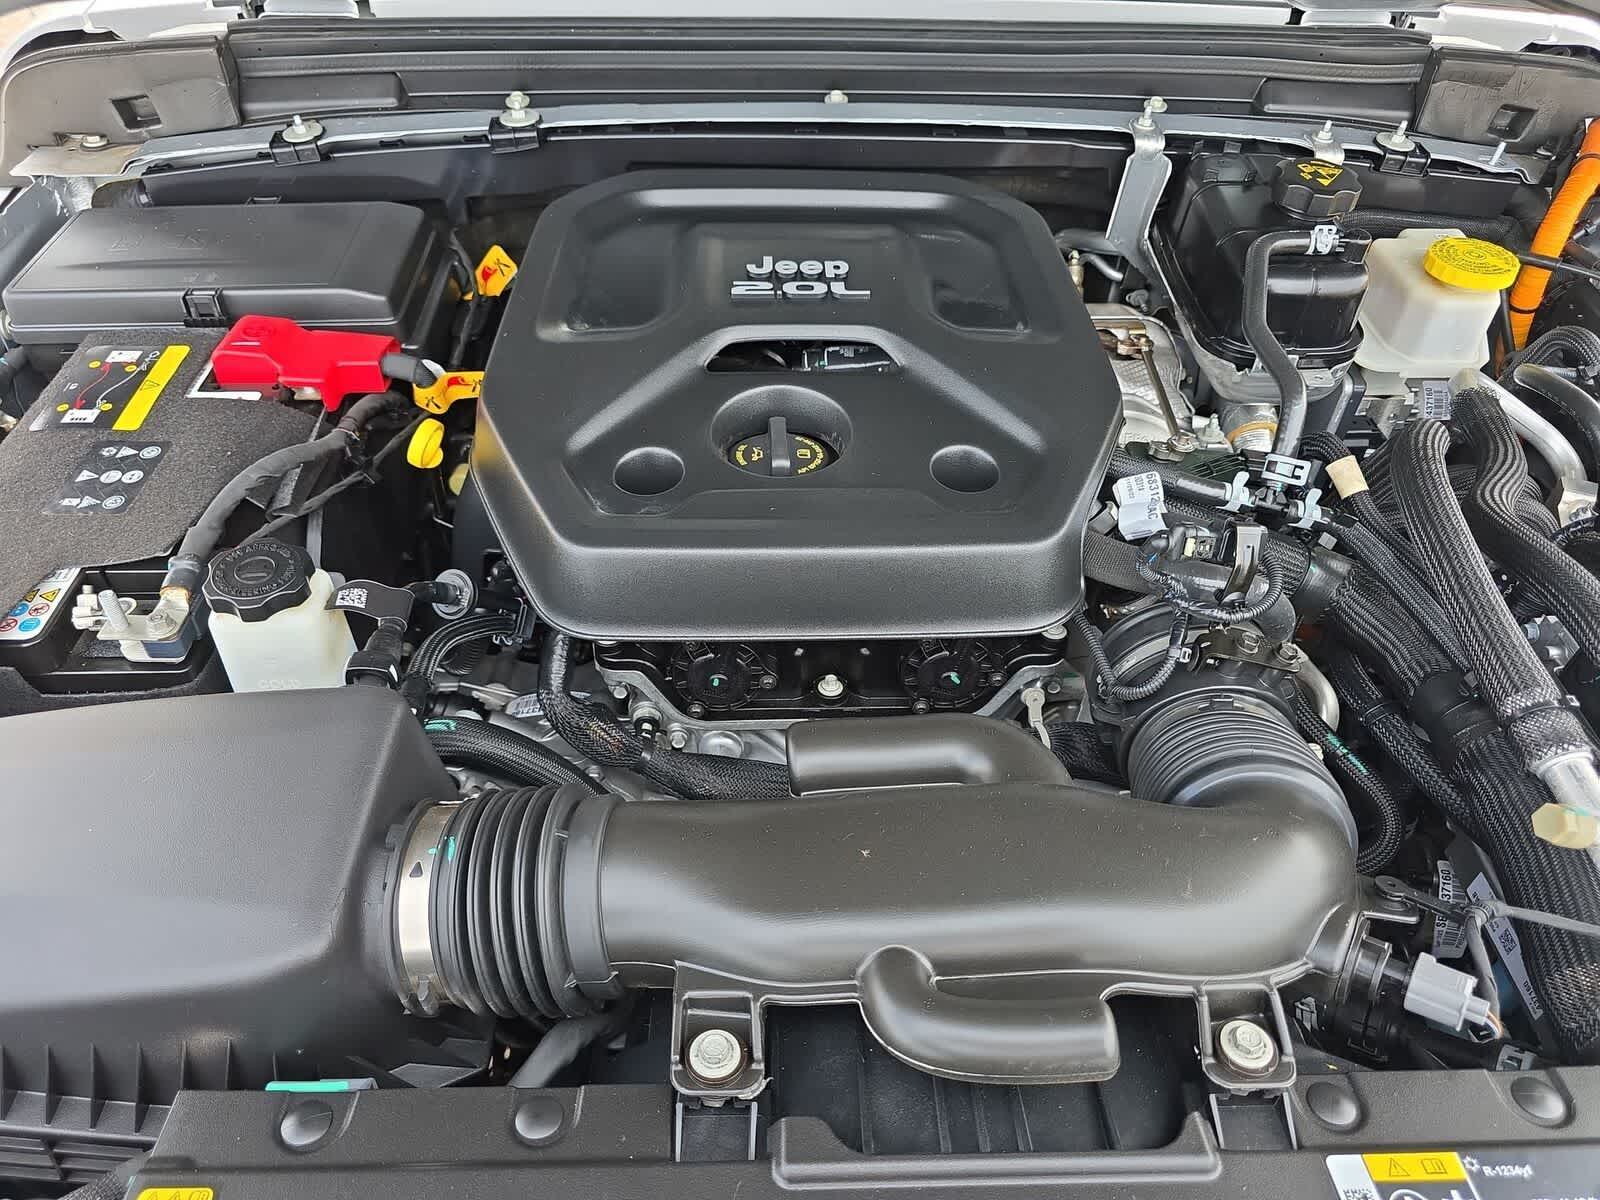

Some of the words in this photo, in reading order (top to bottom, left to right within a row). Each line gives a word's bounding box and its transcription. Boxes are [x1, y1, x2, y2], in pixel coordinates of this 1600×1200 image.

[746, 255, 849, 278] Jeep
[731, 281, 870, 298] 2.0L
[1482, 1164, 1533, 1178] R-1234yf
